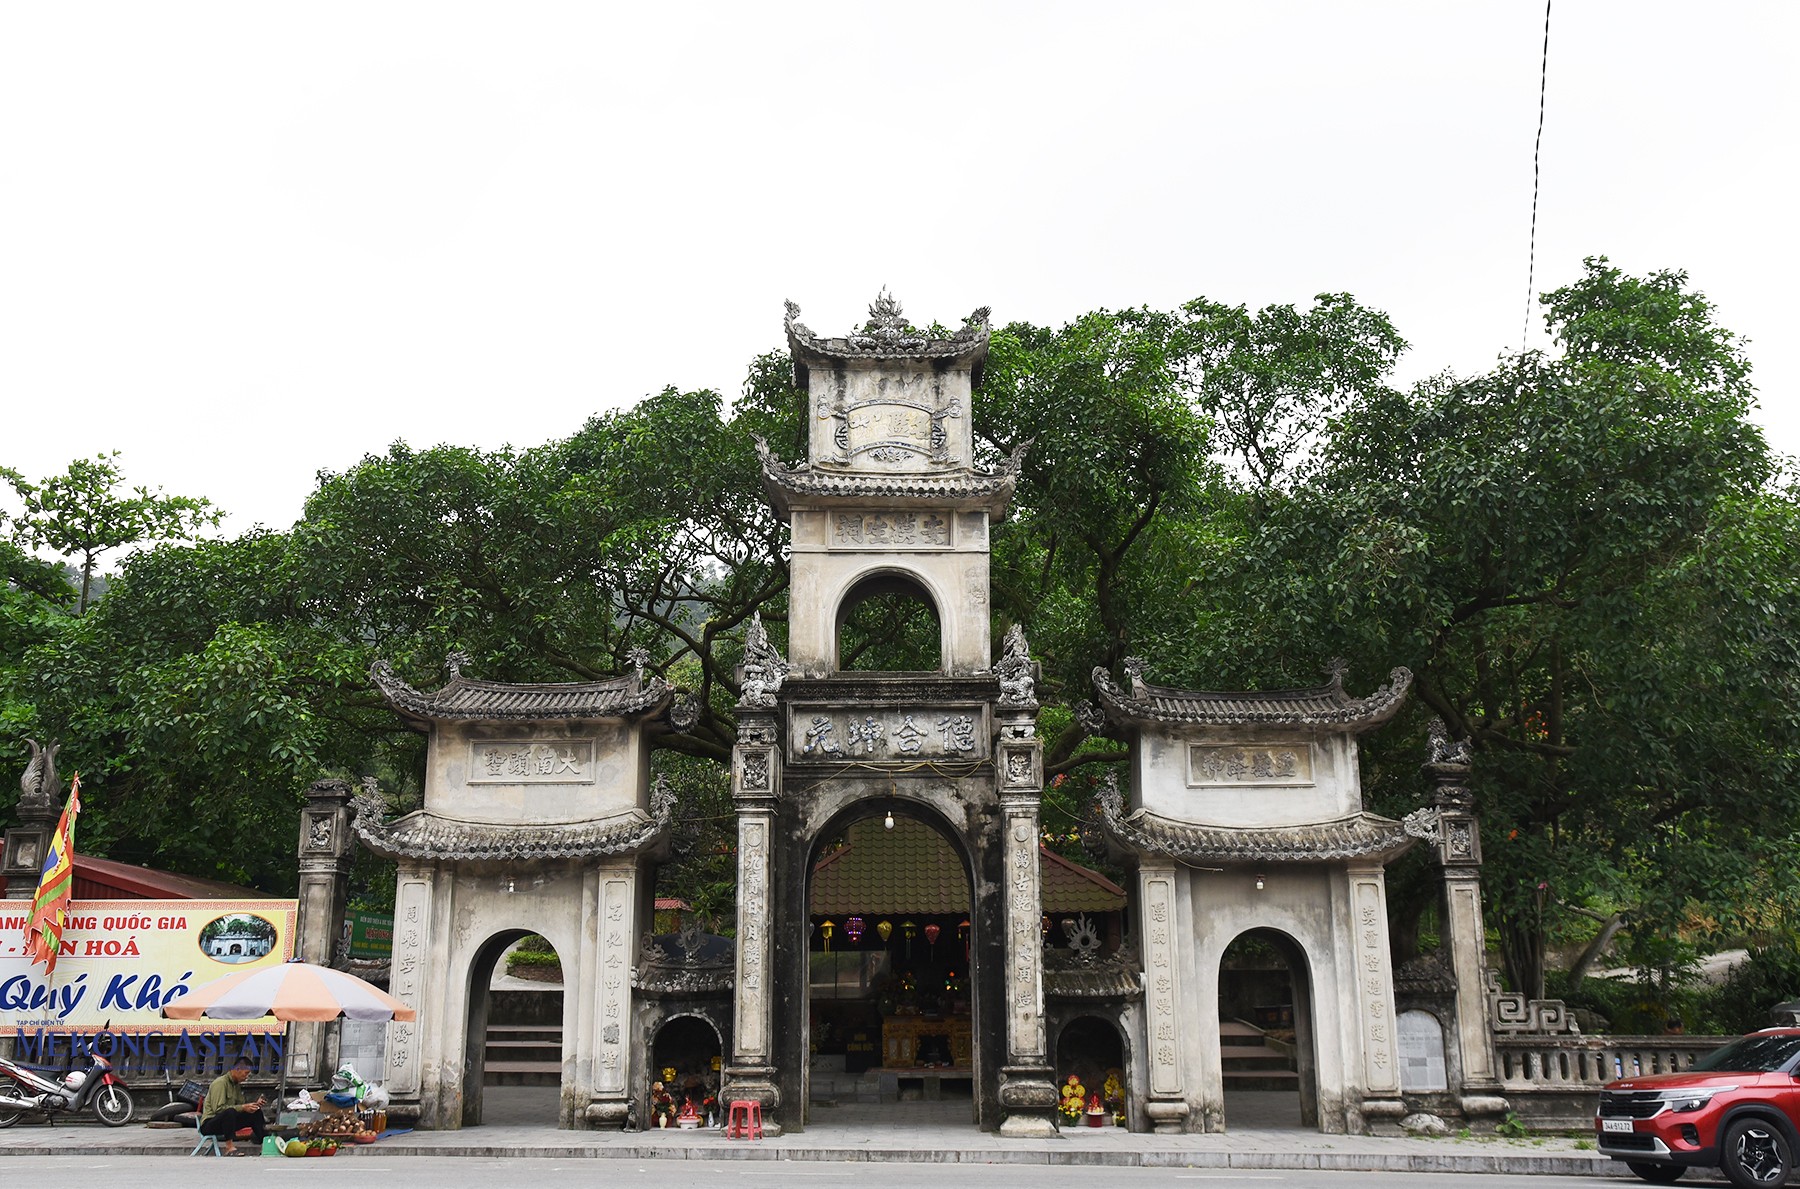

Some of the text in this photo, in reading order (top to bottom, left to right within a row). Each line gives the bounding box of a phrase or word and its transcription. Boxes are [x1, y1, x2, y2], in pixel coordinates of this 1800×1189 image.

[103, 912, 152, 931] QUỐC
[157, 916, 188, 930] GIA
[85, 935, 141, 956] HOÁ
[0, 973, 88, 1019] Quý
